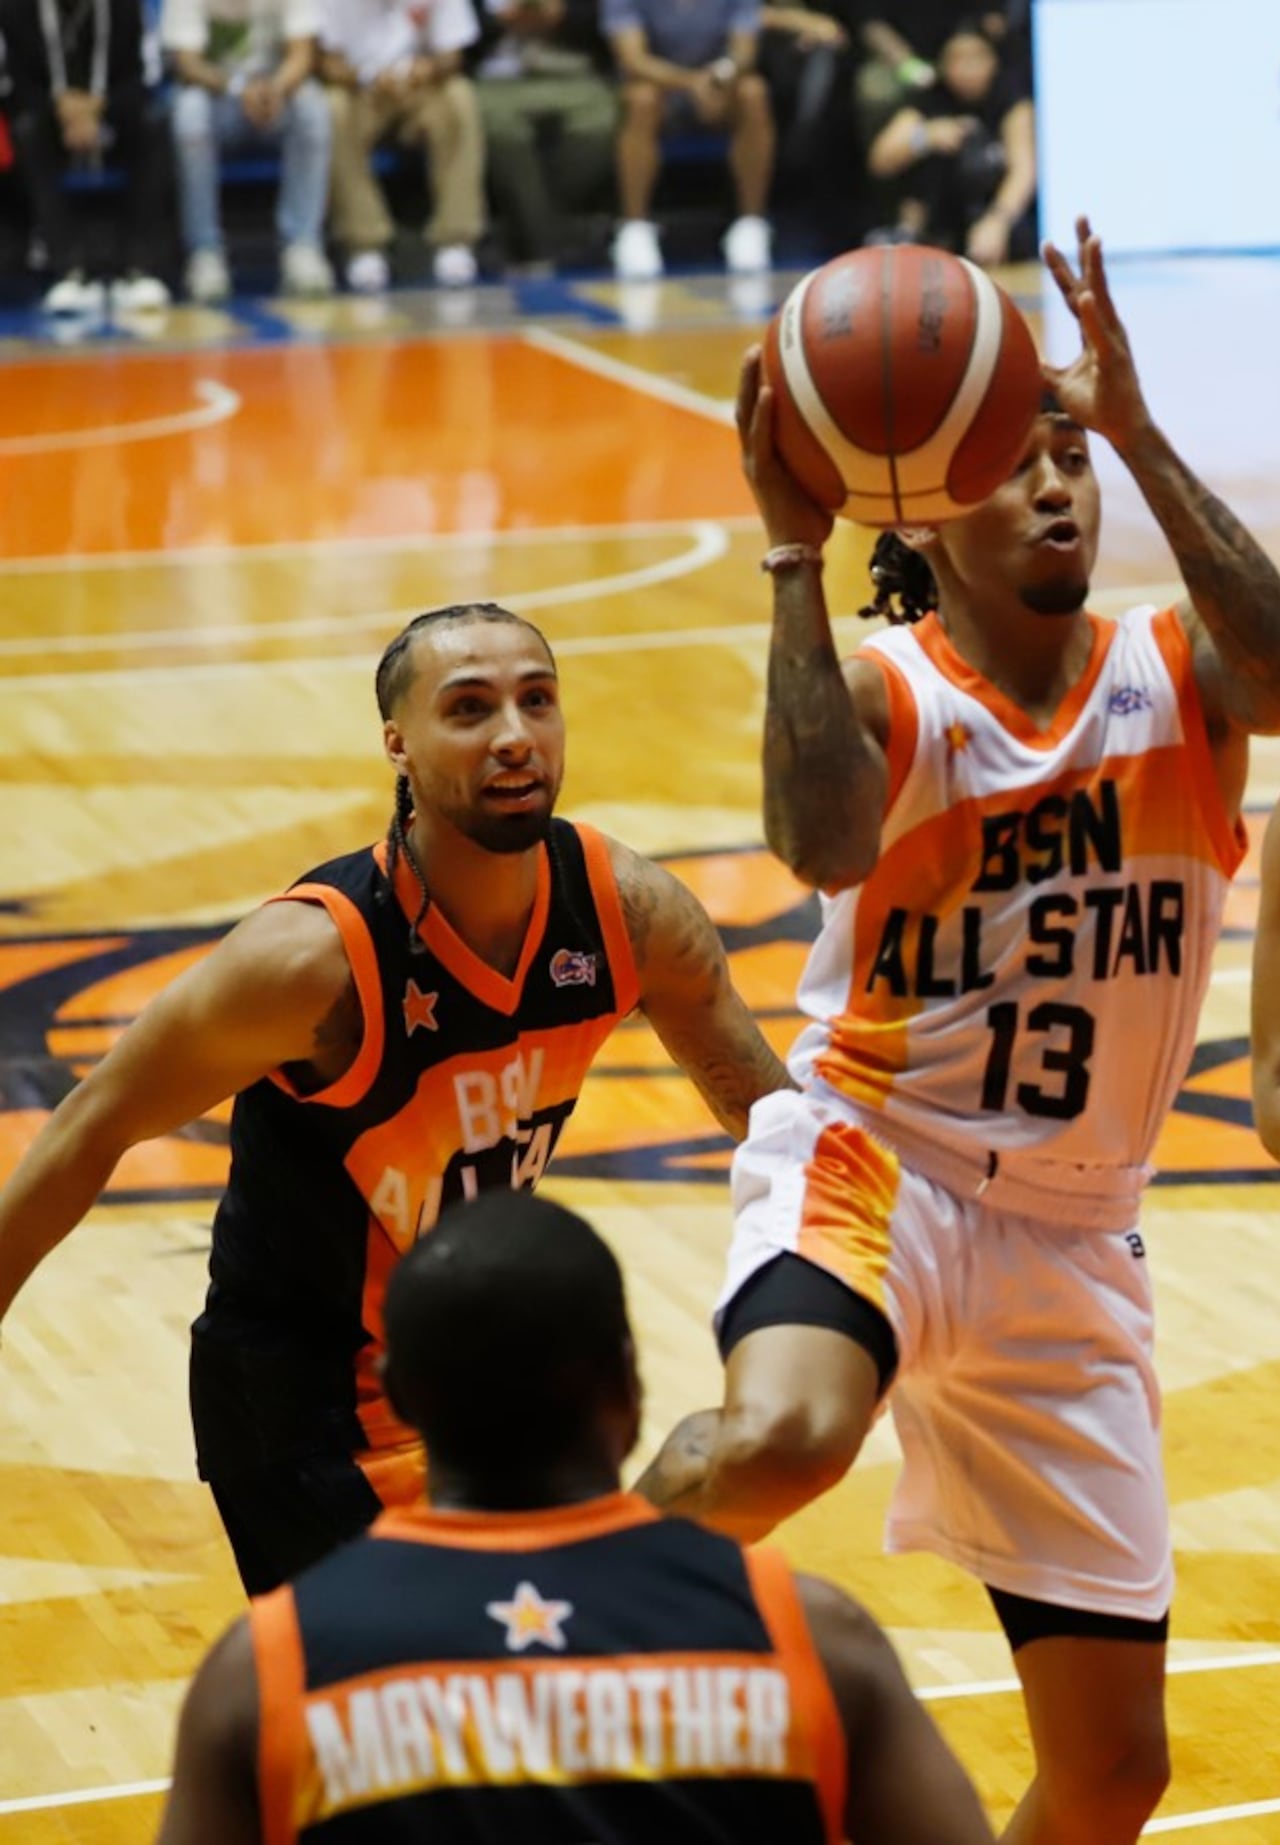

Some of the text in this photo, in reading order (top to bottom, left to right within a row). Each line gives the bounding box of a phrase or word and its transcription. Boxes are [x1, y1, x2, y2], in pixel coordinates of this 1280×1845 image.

[972, 779, 1121, 892] BSN
[866, 881, 1184, 998] ALL STAR
[981, 1001, 1096, 1121] 13
